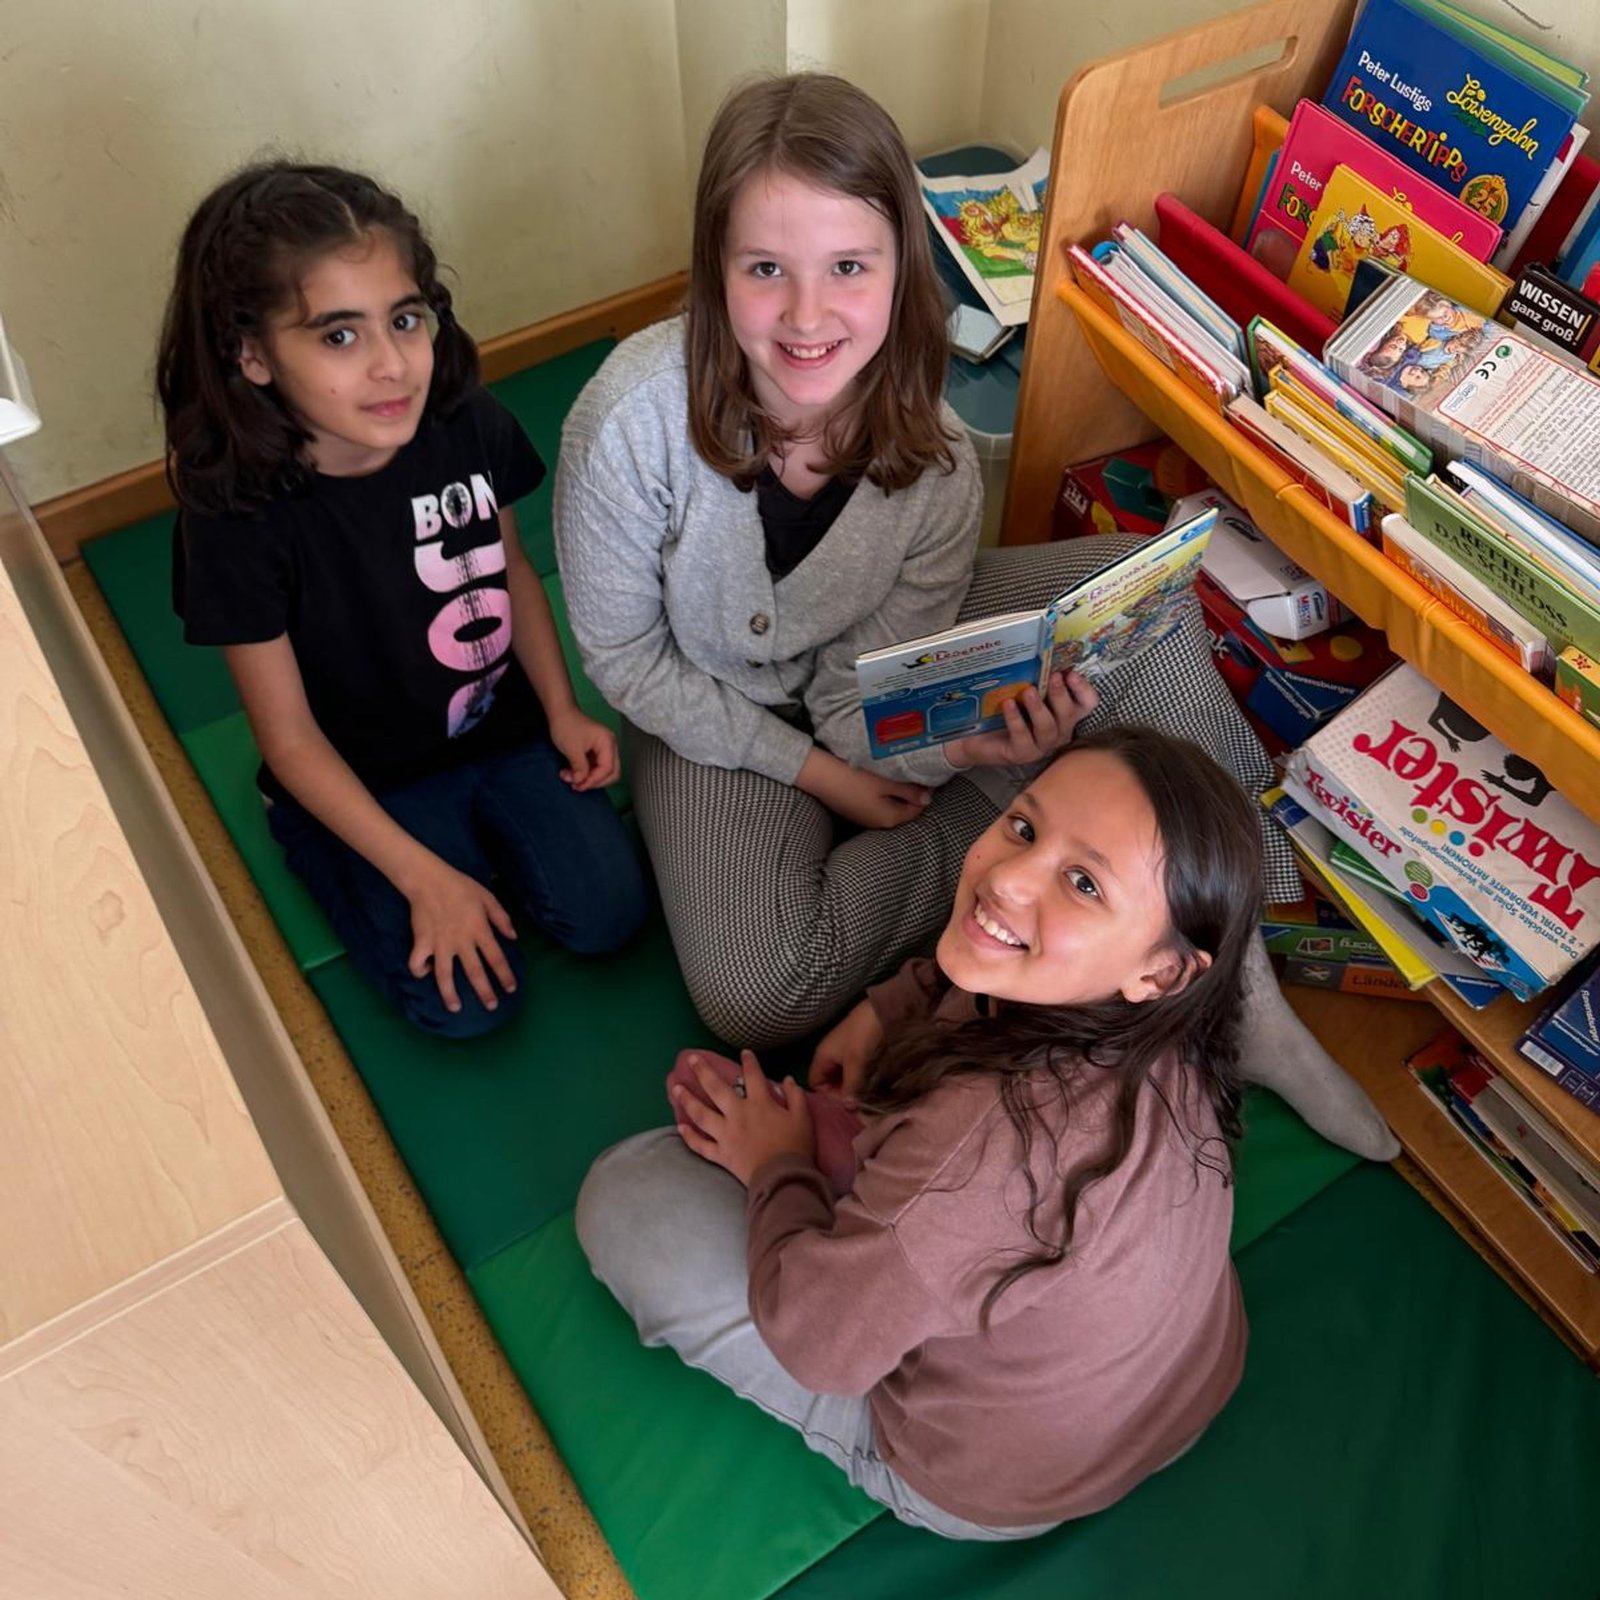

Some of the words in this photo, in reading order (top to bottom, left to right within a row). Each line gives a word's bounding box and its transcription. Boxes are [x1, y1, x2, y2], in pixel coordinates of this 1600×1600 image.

[1357, 50, 1390, 82] Peter
[1390, 73, 1432, 112] Lustigs
[1446, 73, 1539, 160] Löwenzahn
[1290, 161, 1322, 192] Peter
[1510, 299, 1543, 325] ganz
[1519, 279, 1585, 329] WISSEN
[1476, 552, 1568, 628] SCHLOSS
[1305, 766, 1403, 859] Twister
[1353, 719, 1600, 931] Twister
[1478, 882, 1494, 896] mit
[1493, 894, 1519, 916] Spiel
[1519, 913, 1559, 944] verrückte
[1539, 915, 1568, 939] TOTAL
[1568, 934, 1577, 944] 2
[1559, 942, 1578, 960] Das
